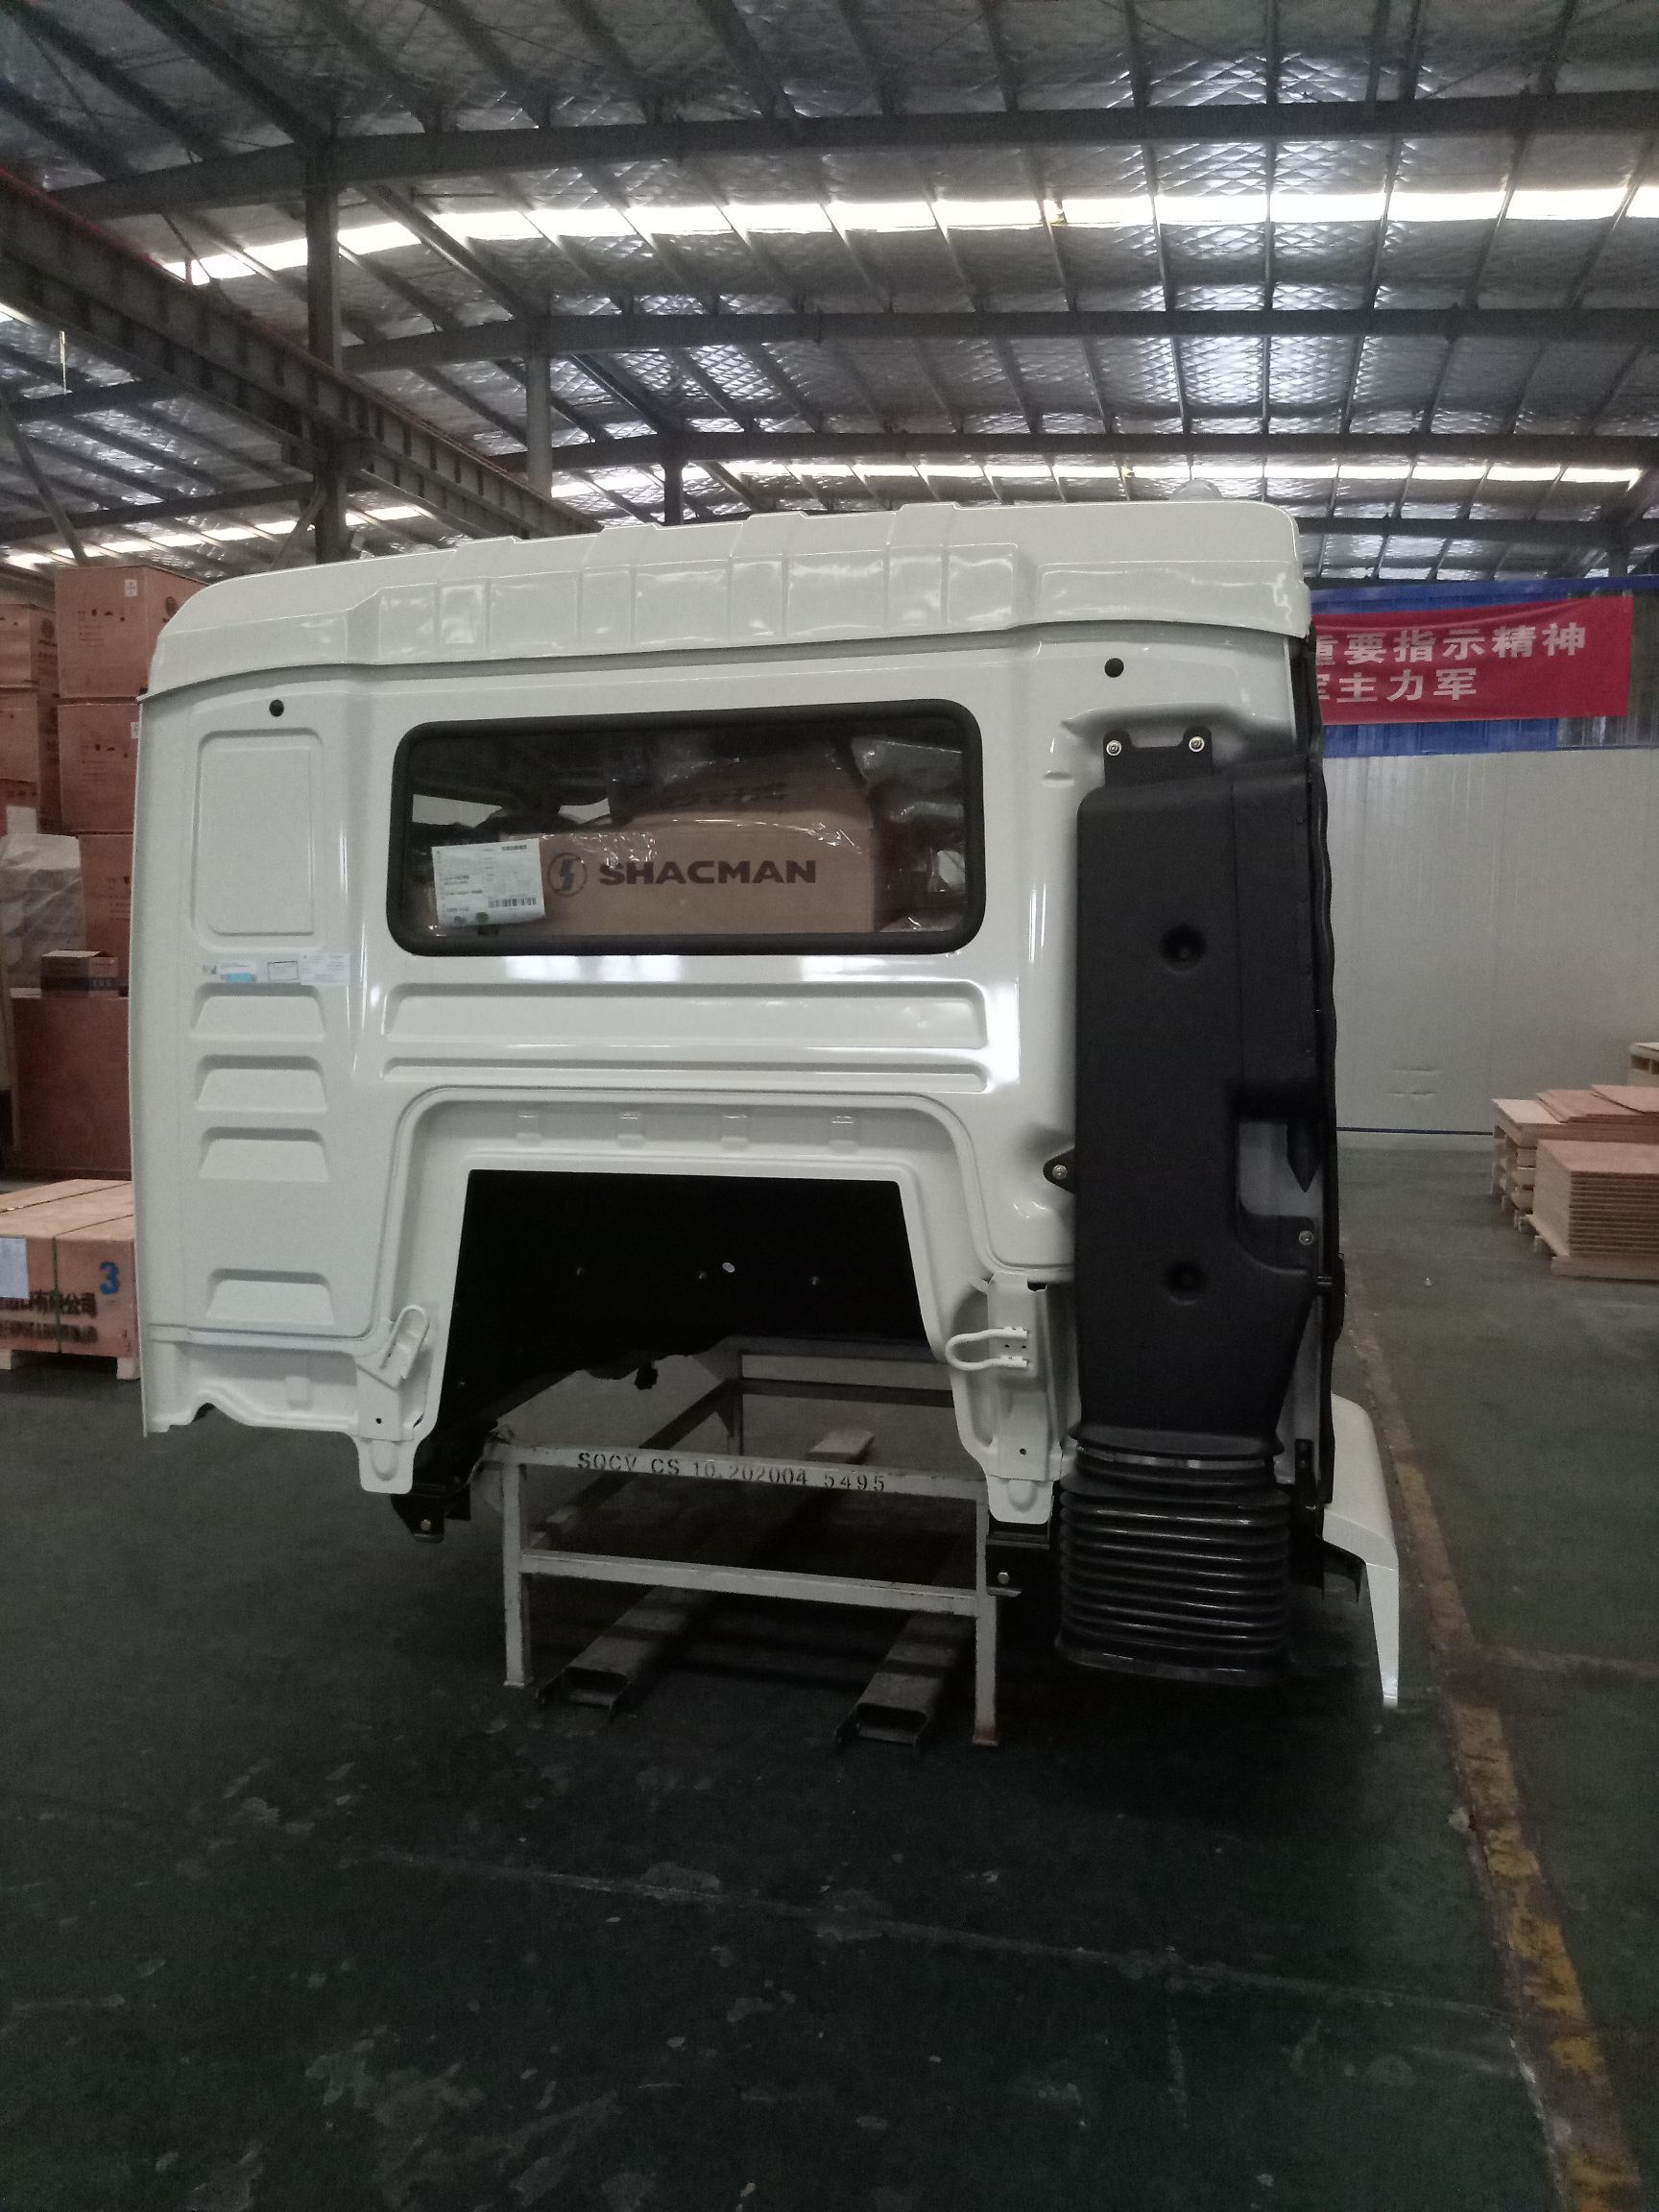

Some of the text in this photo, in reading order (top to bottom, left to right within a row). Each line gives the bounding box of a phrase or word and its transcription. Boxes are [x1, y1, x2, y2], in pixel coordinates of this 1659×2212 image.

[599, 859, 816, 885] SHACMAN
[100, 1262, 120, 1294] 3
[651, 1458, 680, 1476] CS
